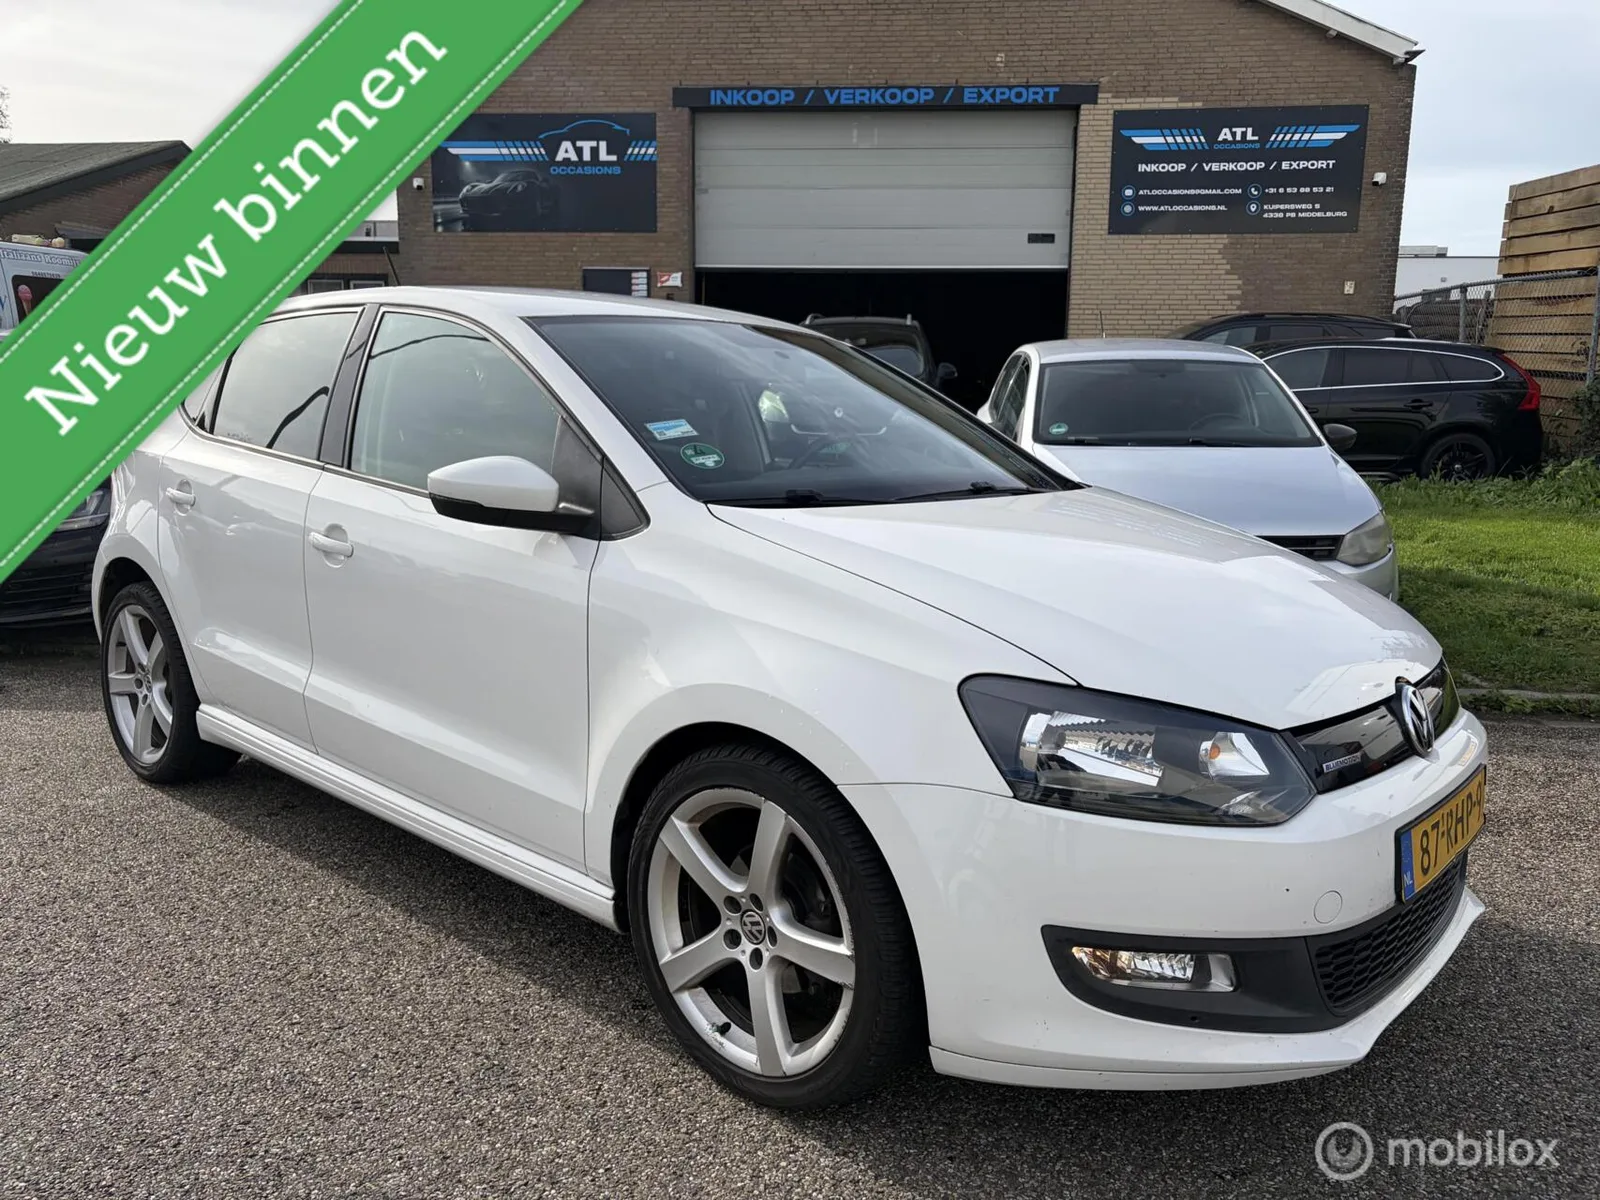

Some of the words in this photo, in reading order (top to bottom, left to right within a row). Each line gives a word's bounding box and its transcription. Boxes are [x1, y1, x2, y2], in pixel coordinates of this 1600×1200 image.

[709, 89, 795, 106] INKOOP
[823, 88, 935, 105] VERKOOP
[963, 86, 1060, 104] EXPORT
[1217, 127, 1259, 141] ATL
[555, 140, 618, 162] ATL
[1213, 142, 1260, 150] OCCASIONS
[550, 166, 621, 175] OCCASIONS
[1138, 163, 1187, 172] INKOOP
[1203, 161, 1265, 171] VERKOOP
[1281, 160, 1336, 170] EXPORT
